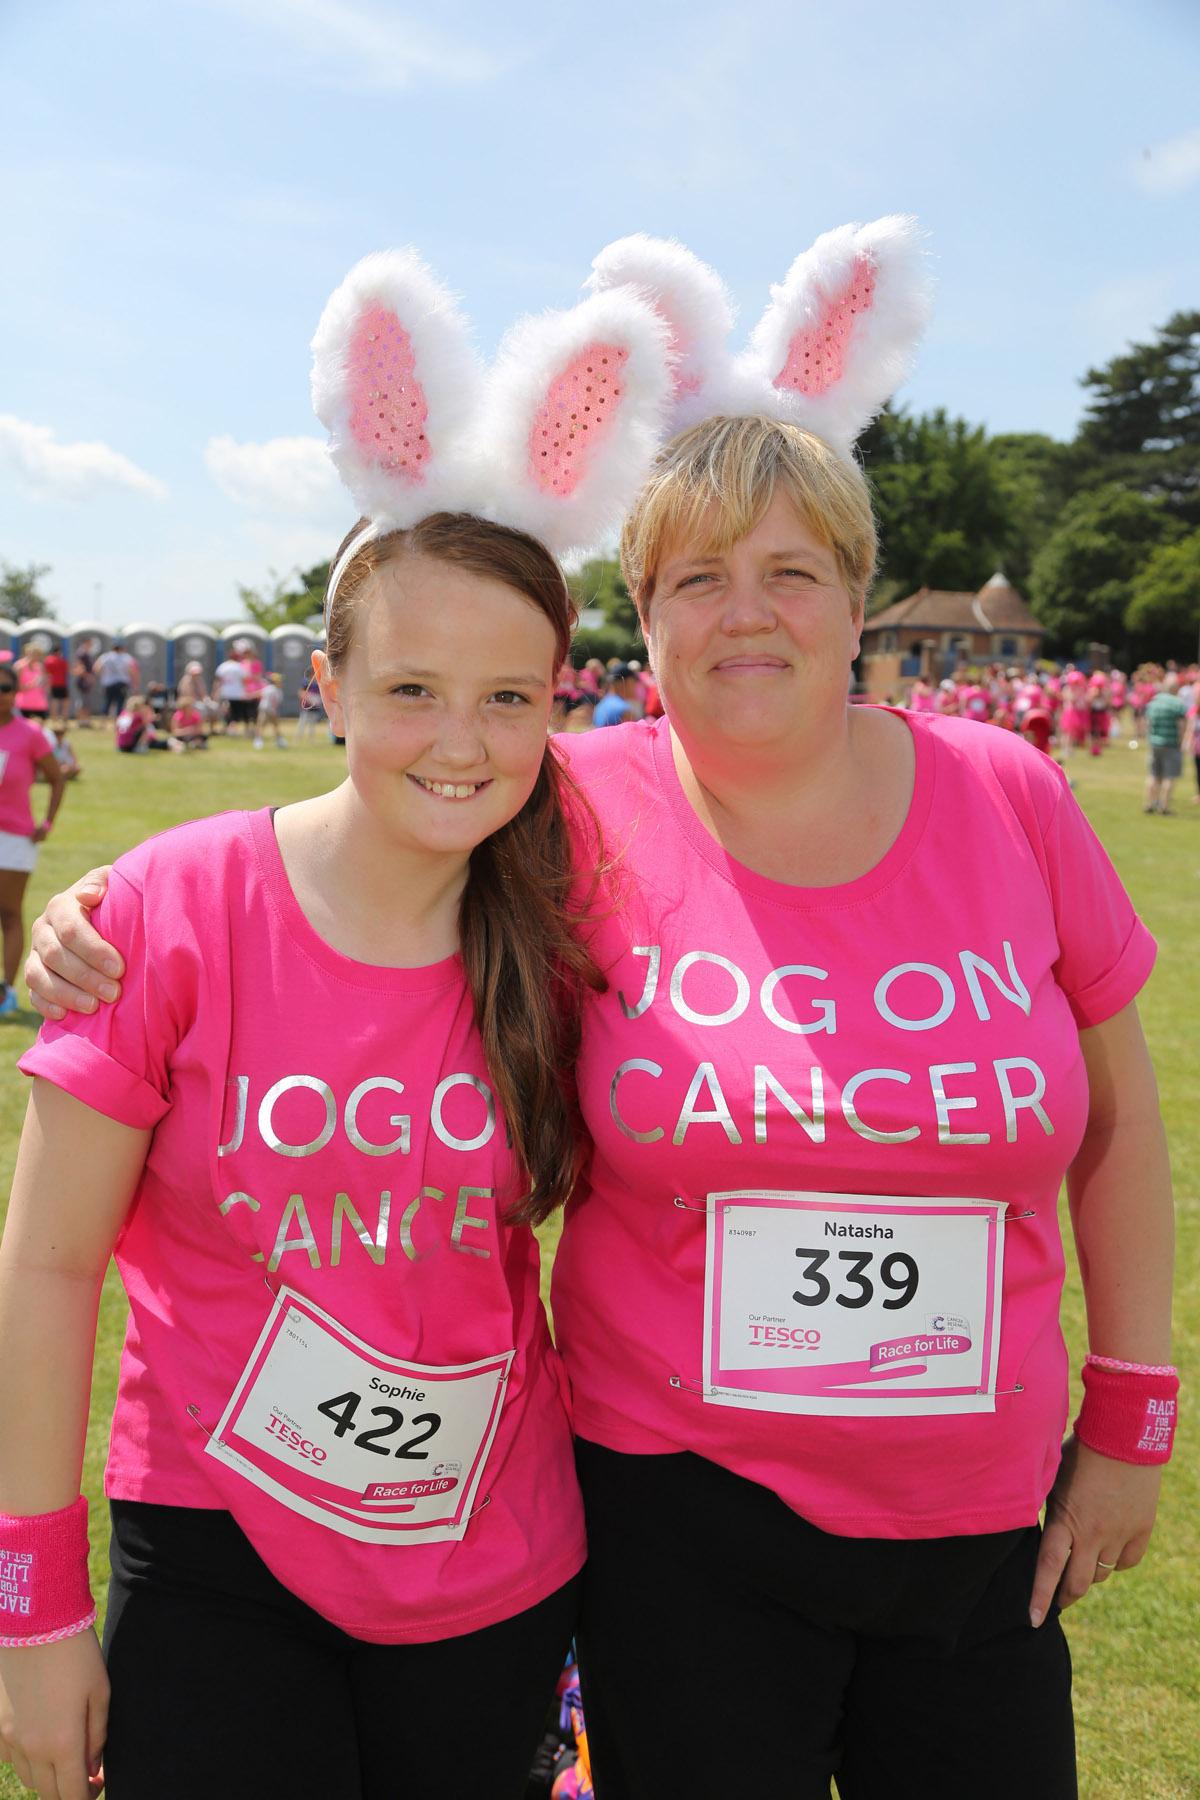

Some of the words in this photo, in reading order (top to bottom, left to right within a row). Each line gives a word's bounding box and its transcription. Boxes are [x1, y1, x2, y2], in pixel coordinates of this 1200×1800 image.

[617, 945, 836, 1034] JOG
[873, 940, 1032, 1031] ON
[609, 1056, 1056, 1146] CANCER
[219, 1186, 496, 1273] CANCE
[824, 1221, 894, 1239] Natasha
[792, 1247, 919, 1310] 339
[763, 1315, 787, 1323] Partner
[748, 1325, 821, 1344] TESCO
[878, 1343, 911, 1360] Race
[915, 1339, 934, 1352] for
[936, 1337, 959, 1350] Life
[368, 1376, 426, 1402] Sophie
[1146, 1398, 1175, 1416] RACE
[317, 1391, 442, 1460] 422
[1142, 1425, 1171, 1441] LIFE
[1155, 1417, 1168, 1426] FOR
[270, 1413, 327, 1461] TESCO
[373, 1486, 407, 1497] Race
[410, 1484, 429, 1494] for
[430, 1480, 449, 1492] Life
[0, 1560, 29, 1583] LIF
